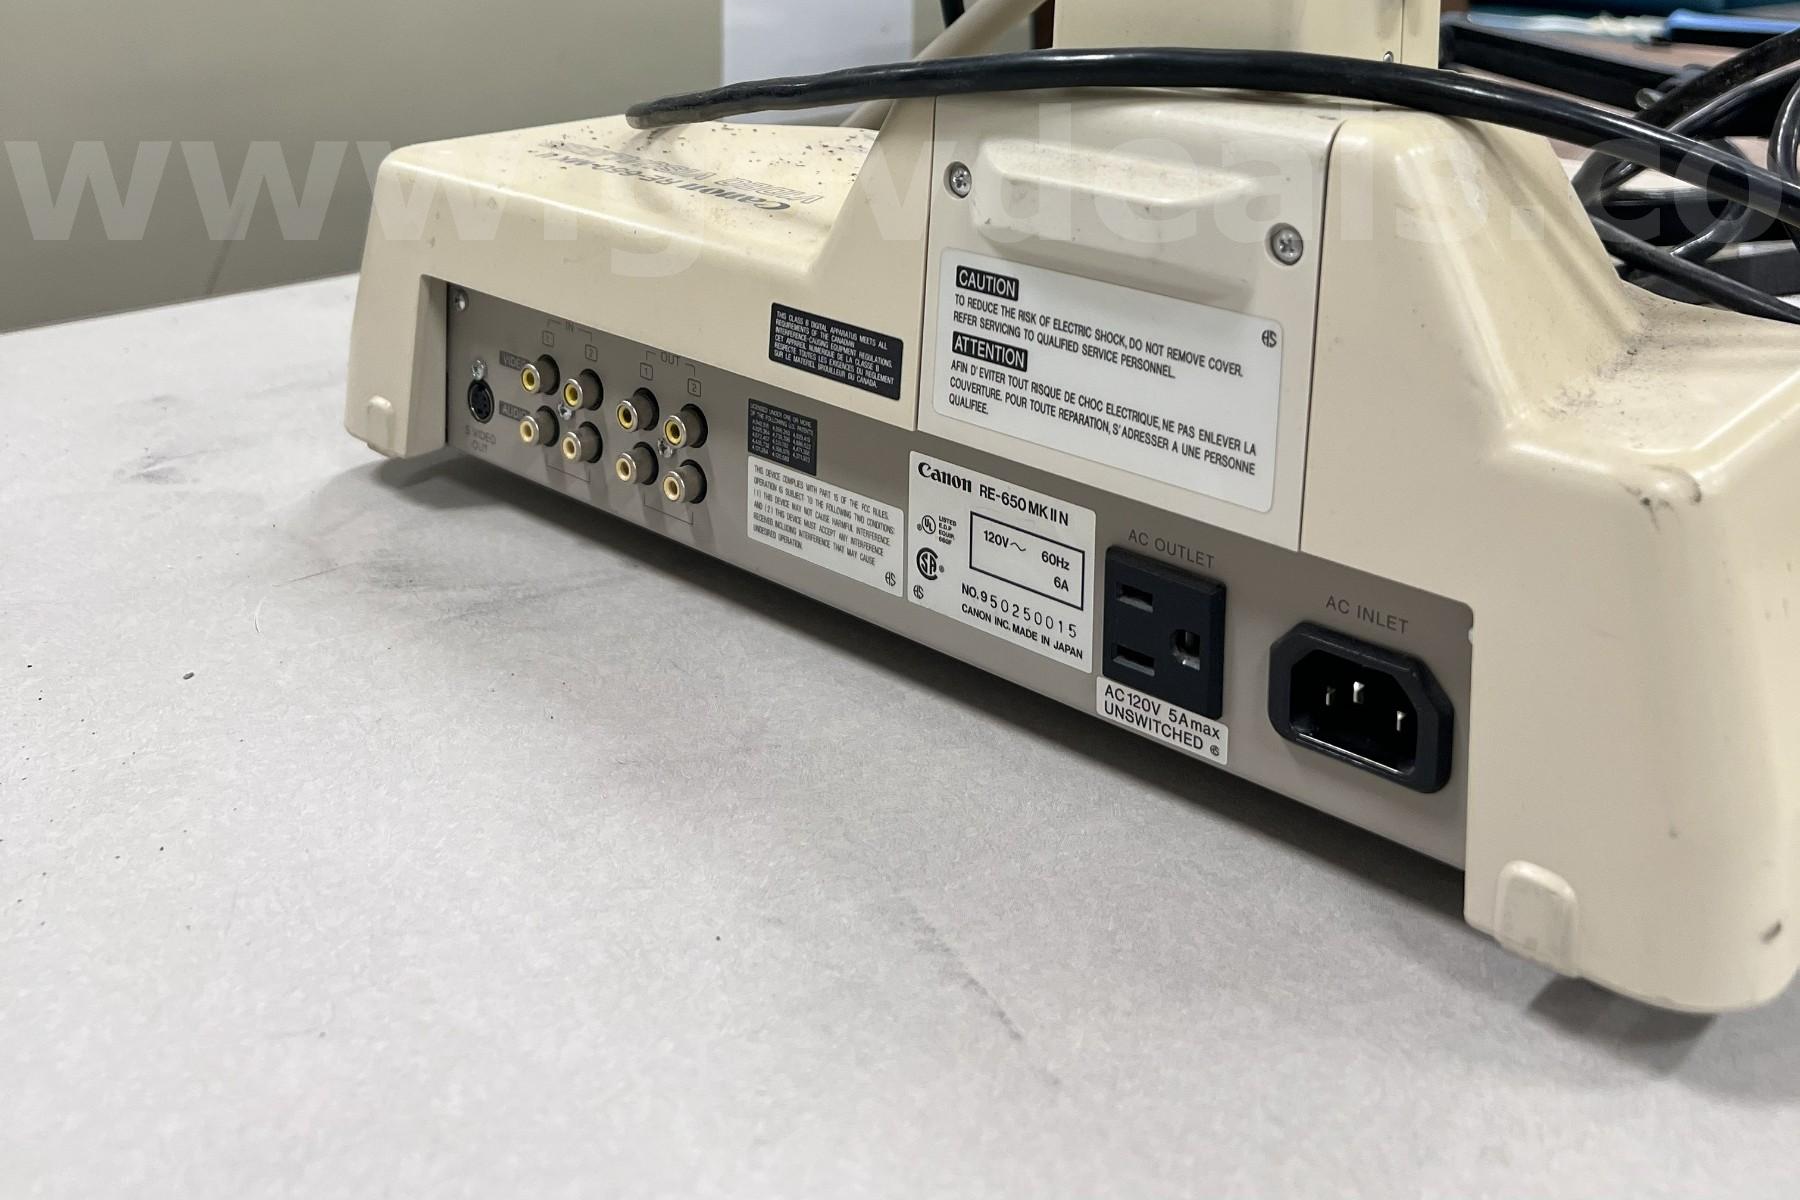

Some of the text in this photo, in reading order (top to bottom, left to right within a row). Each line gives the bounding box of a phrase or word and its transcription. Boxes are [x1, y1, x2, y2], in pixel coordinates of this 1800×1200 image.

[677, 182, 791, 211] Canon
[959, 269, 1015, 297] CAUTION
[953, 310, 977, 326] REFER
[979, 316, 1020, 338] SERVICING
[1023, 328, 1034, 341] TO
[1036, 331, 1078, 352] QUALIFIED
[1081, 343, 1118, 363] SERVICE
[954, 293, 965, 306] TO
[967, 296, 998, 315] REDUCE
[1000, 304, 1015, 319] THE
[1017, 309, 1036, 324] RISK
[1038, 314, 1050, 327] OF
[1052, 317, 1091, 338] ELECTRIC
[1128, 336, 1142, 351] DO
[1145, 341, 1164, 356] NOT
[1166, 346, 1205, 367] REMOVE
[660, 351, 681, 367] OUT
[954, 334, 1024, 368] ATTENTION
[950, 359, 967, 373] AFIN
[1007, 374, 1028, 390] TOUT
[1030, 381, 1061, 400] RISQUE
[1063, 390, 1075, 404] DE
[1077, 394, 1103, 412] CHOC
[1162, 418, 1174, 432] NE
[1177, 422, 1194, 438] PAS
[1198, 428, 1240, 451] ENLEVER
[1243, 441, 1256, 456] LA
[1004, 391, 1027, 408] POUR
[1029, 398, 1056, 417] TOUTE
[1171, 440, 1178, 453] A
[1181, 443, 1200, 459] UNE
[1203, 449, 1255, 475] PERSONNE
[917, 462, 971, 492] Canon
[1041, 550, 1069, 570] 60Hz
[1128, 529, 1215, 569] AC OUTLET
[1053, 576, 1068, 591] 6A
[961, 603, 991, 622] CANON
[1041, 634, 1049, 646] IN
[1053, 640, 1082, 659] JAPAN
[1325, 594, 1409, 635] AC INLET
[1104, 700, 1203, 749] UNSWITCHED
